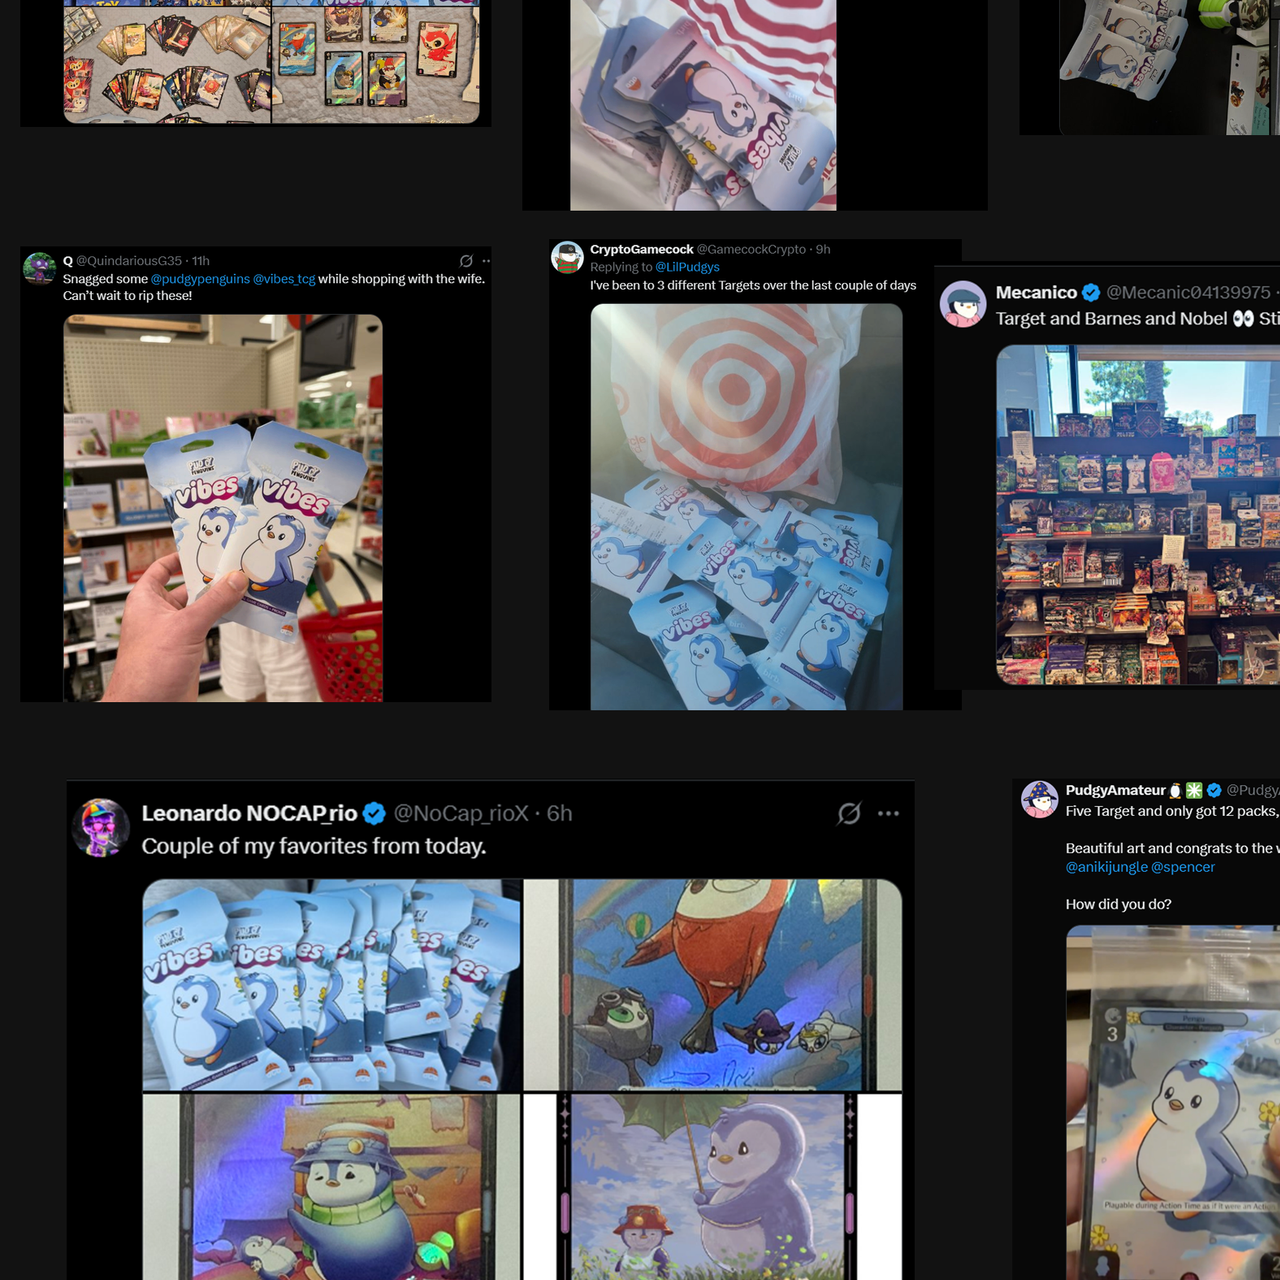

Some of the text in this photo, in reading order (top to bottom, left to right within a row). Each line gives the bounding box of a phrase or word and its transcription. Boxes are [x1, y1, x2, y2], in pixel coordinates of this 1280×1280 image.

[995, 310, 1228, 330] Target and Barnes and Nobel
[1066, 897, 1173, 913] How did you do?
